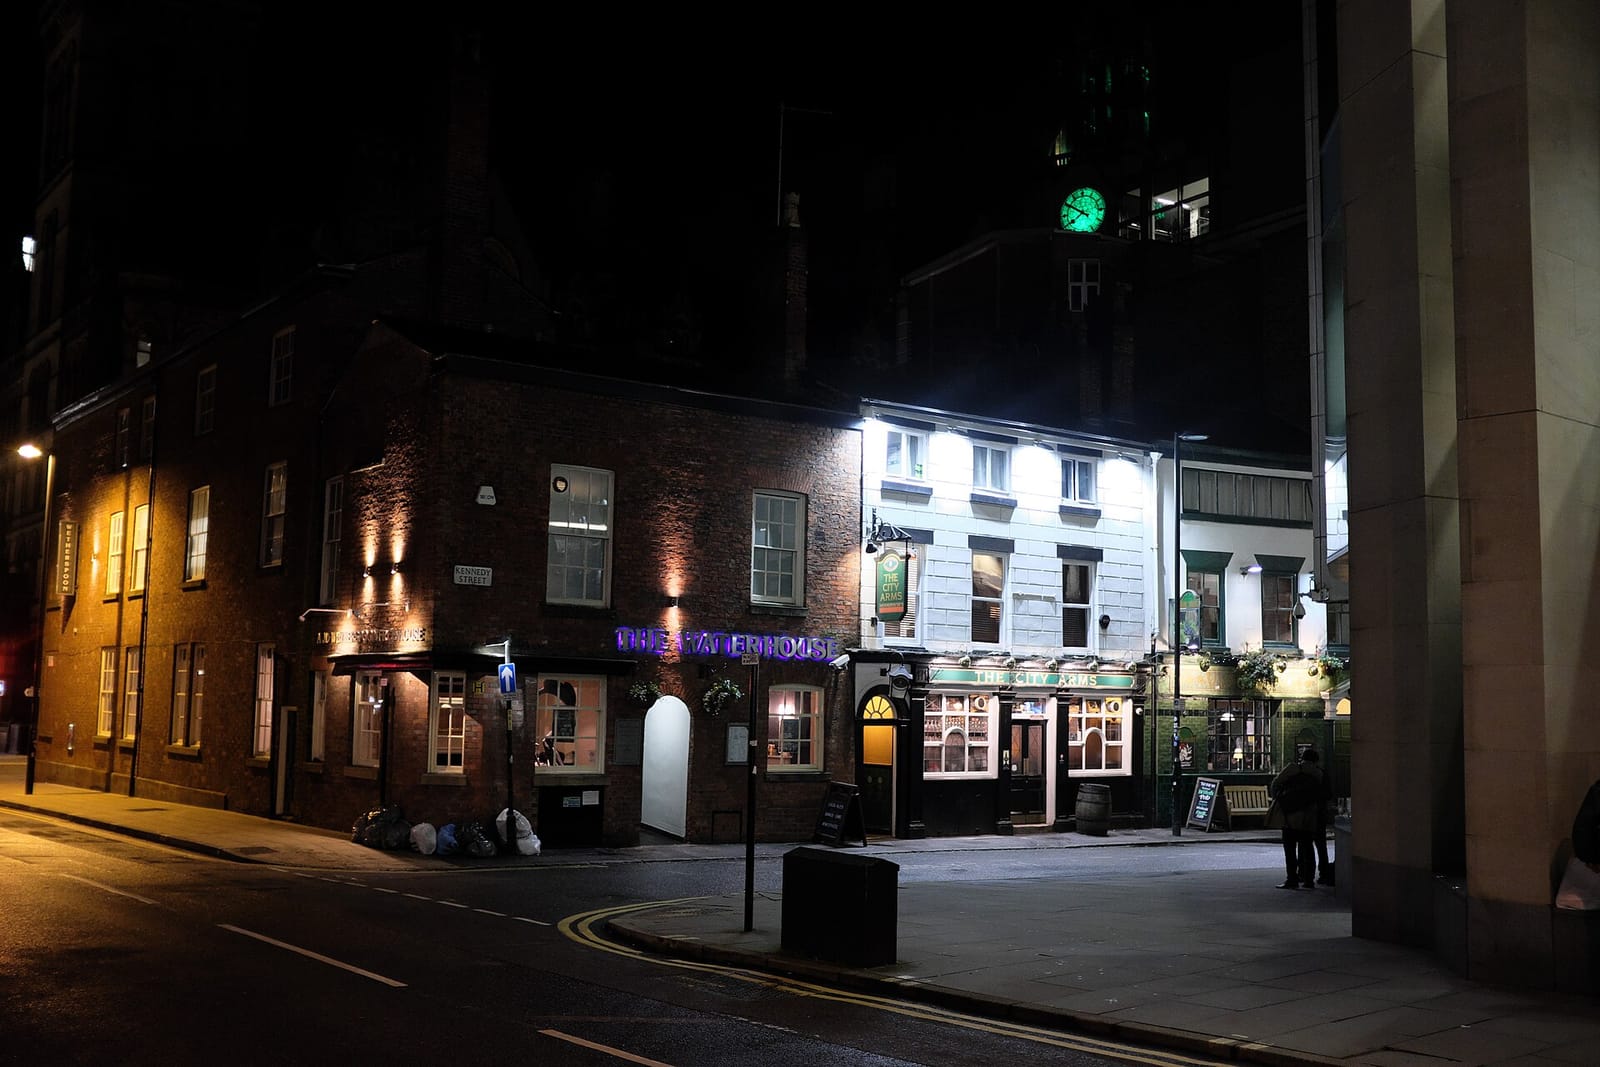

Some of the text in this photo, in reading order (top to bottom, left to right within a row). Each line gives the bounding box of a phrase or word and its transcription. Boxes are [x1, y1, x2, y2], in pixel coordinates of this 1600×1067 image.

[455, 567, 491, 577] KENNEDY
[458, 575, 487, 584] STREET
[883, 573, 899, 583] THE
[882, 582, 900, 592] CITY
[880, 592, 903, 602] ARMS
[615, 627, 841, 660] THE WATERHOUSE
[974, 671, 1098, 687] THE CITY ARMS
